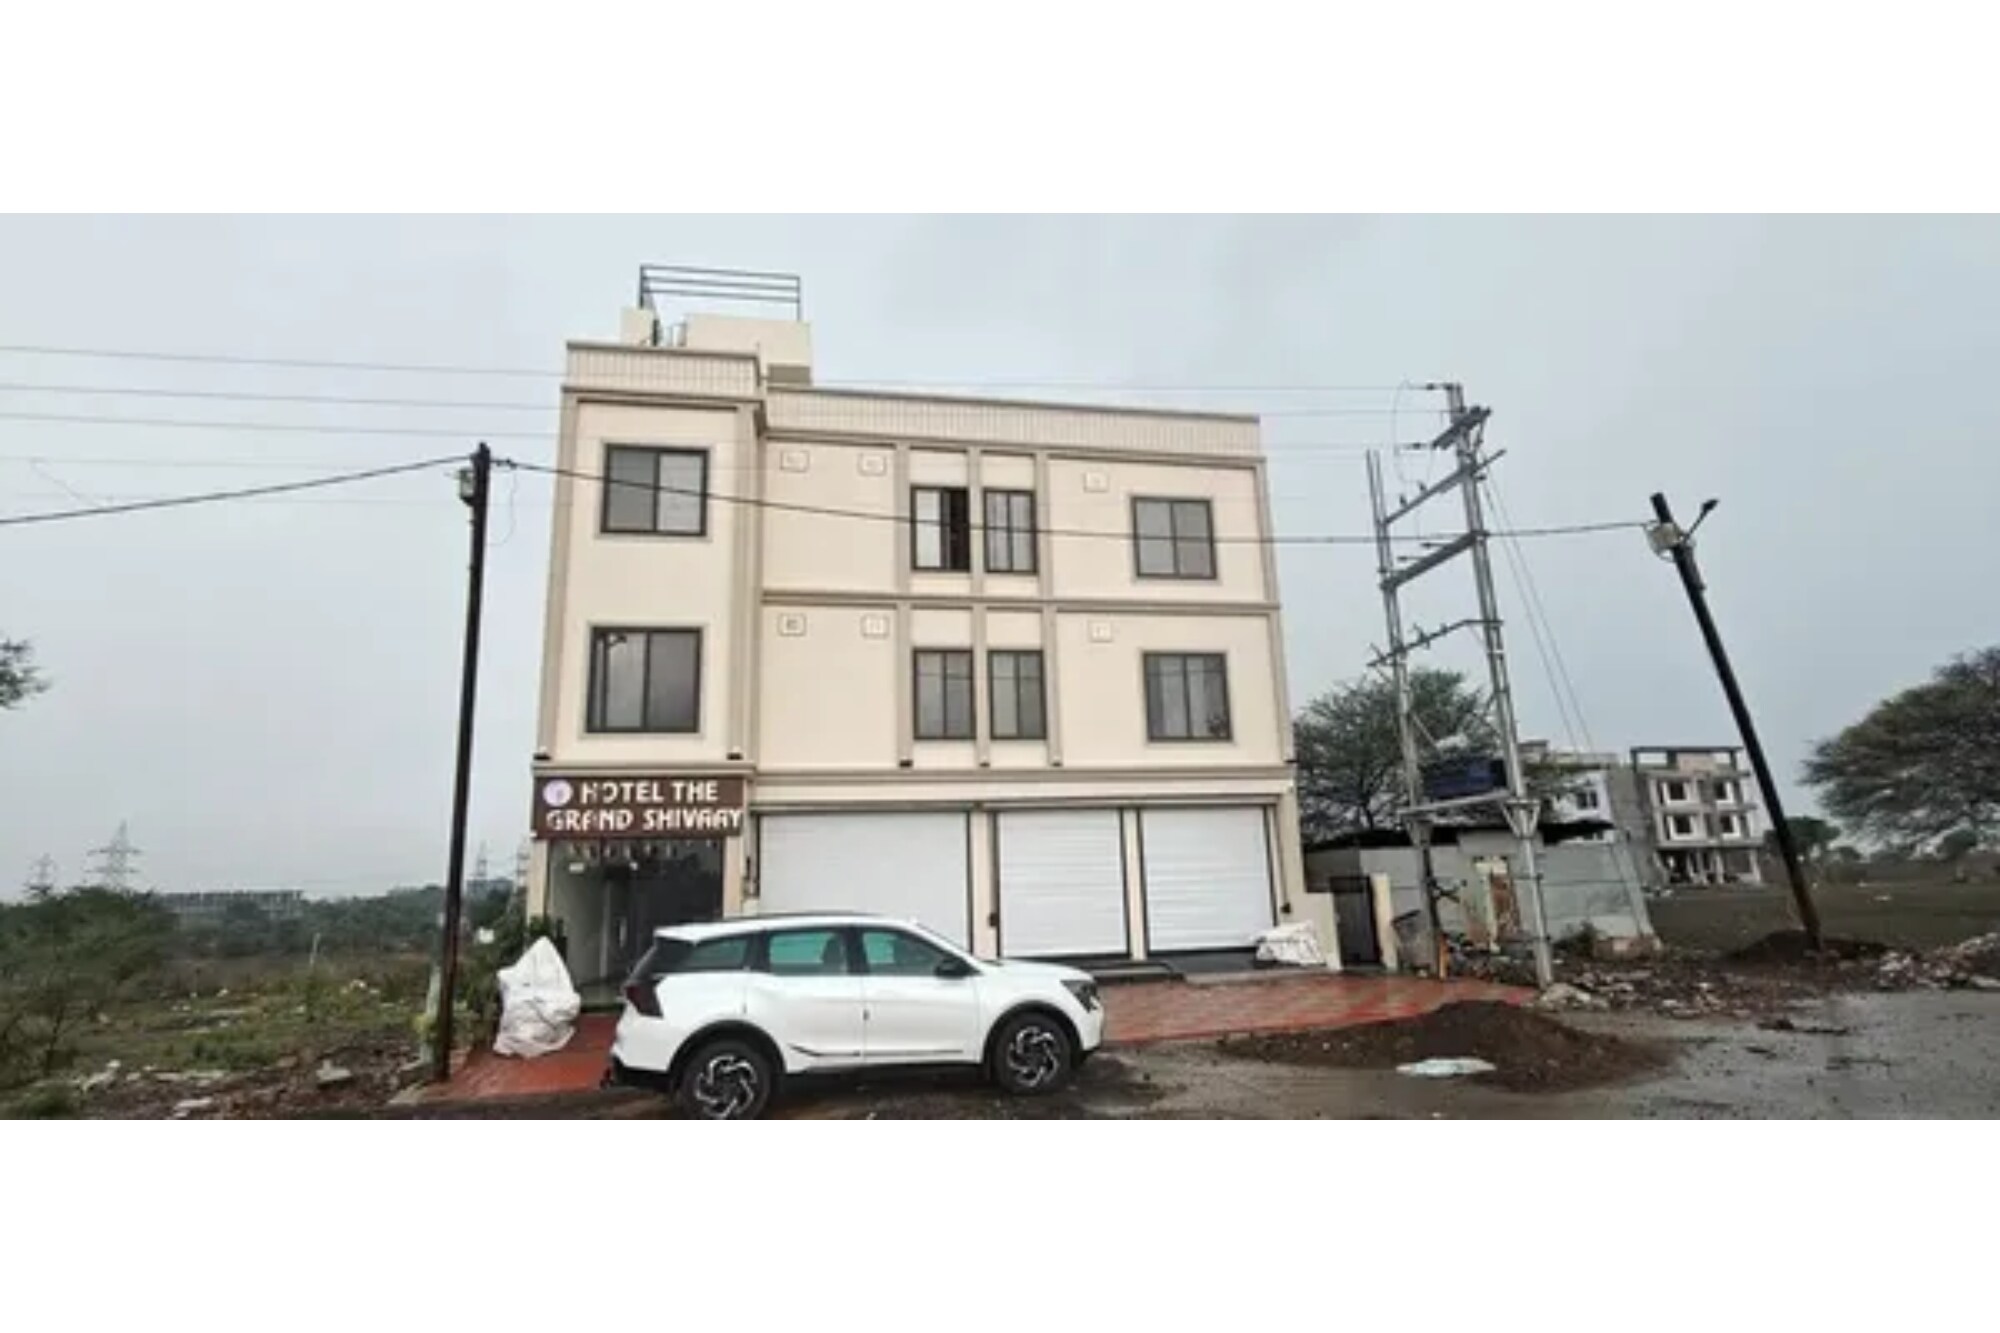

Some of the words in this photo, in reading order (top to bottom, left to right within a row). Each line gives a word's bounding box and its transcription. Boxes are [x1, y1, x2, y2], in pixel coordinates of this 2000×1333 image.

[580, 780, 664, 804] HOTEL
[672, 780, 718, 804] THE
[546, 808, 634, 832] GRAND
[643, 808, 742, 831] SHIVAAY
